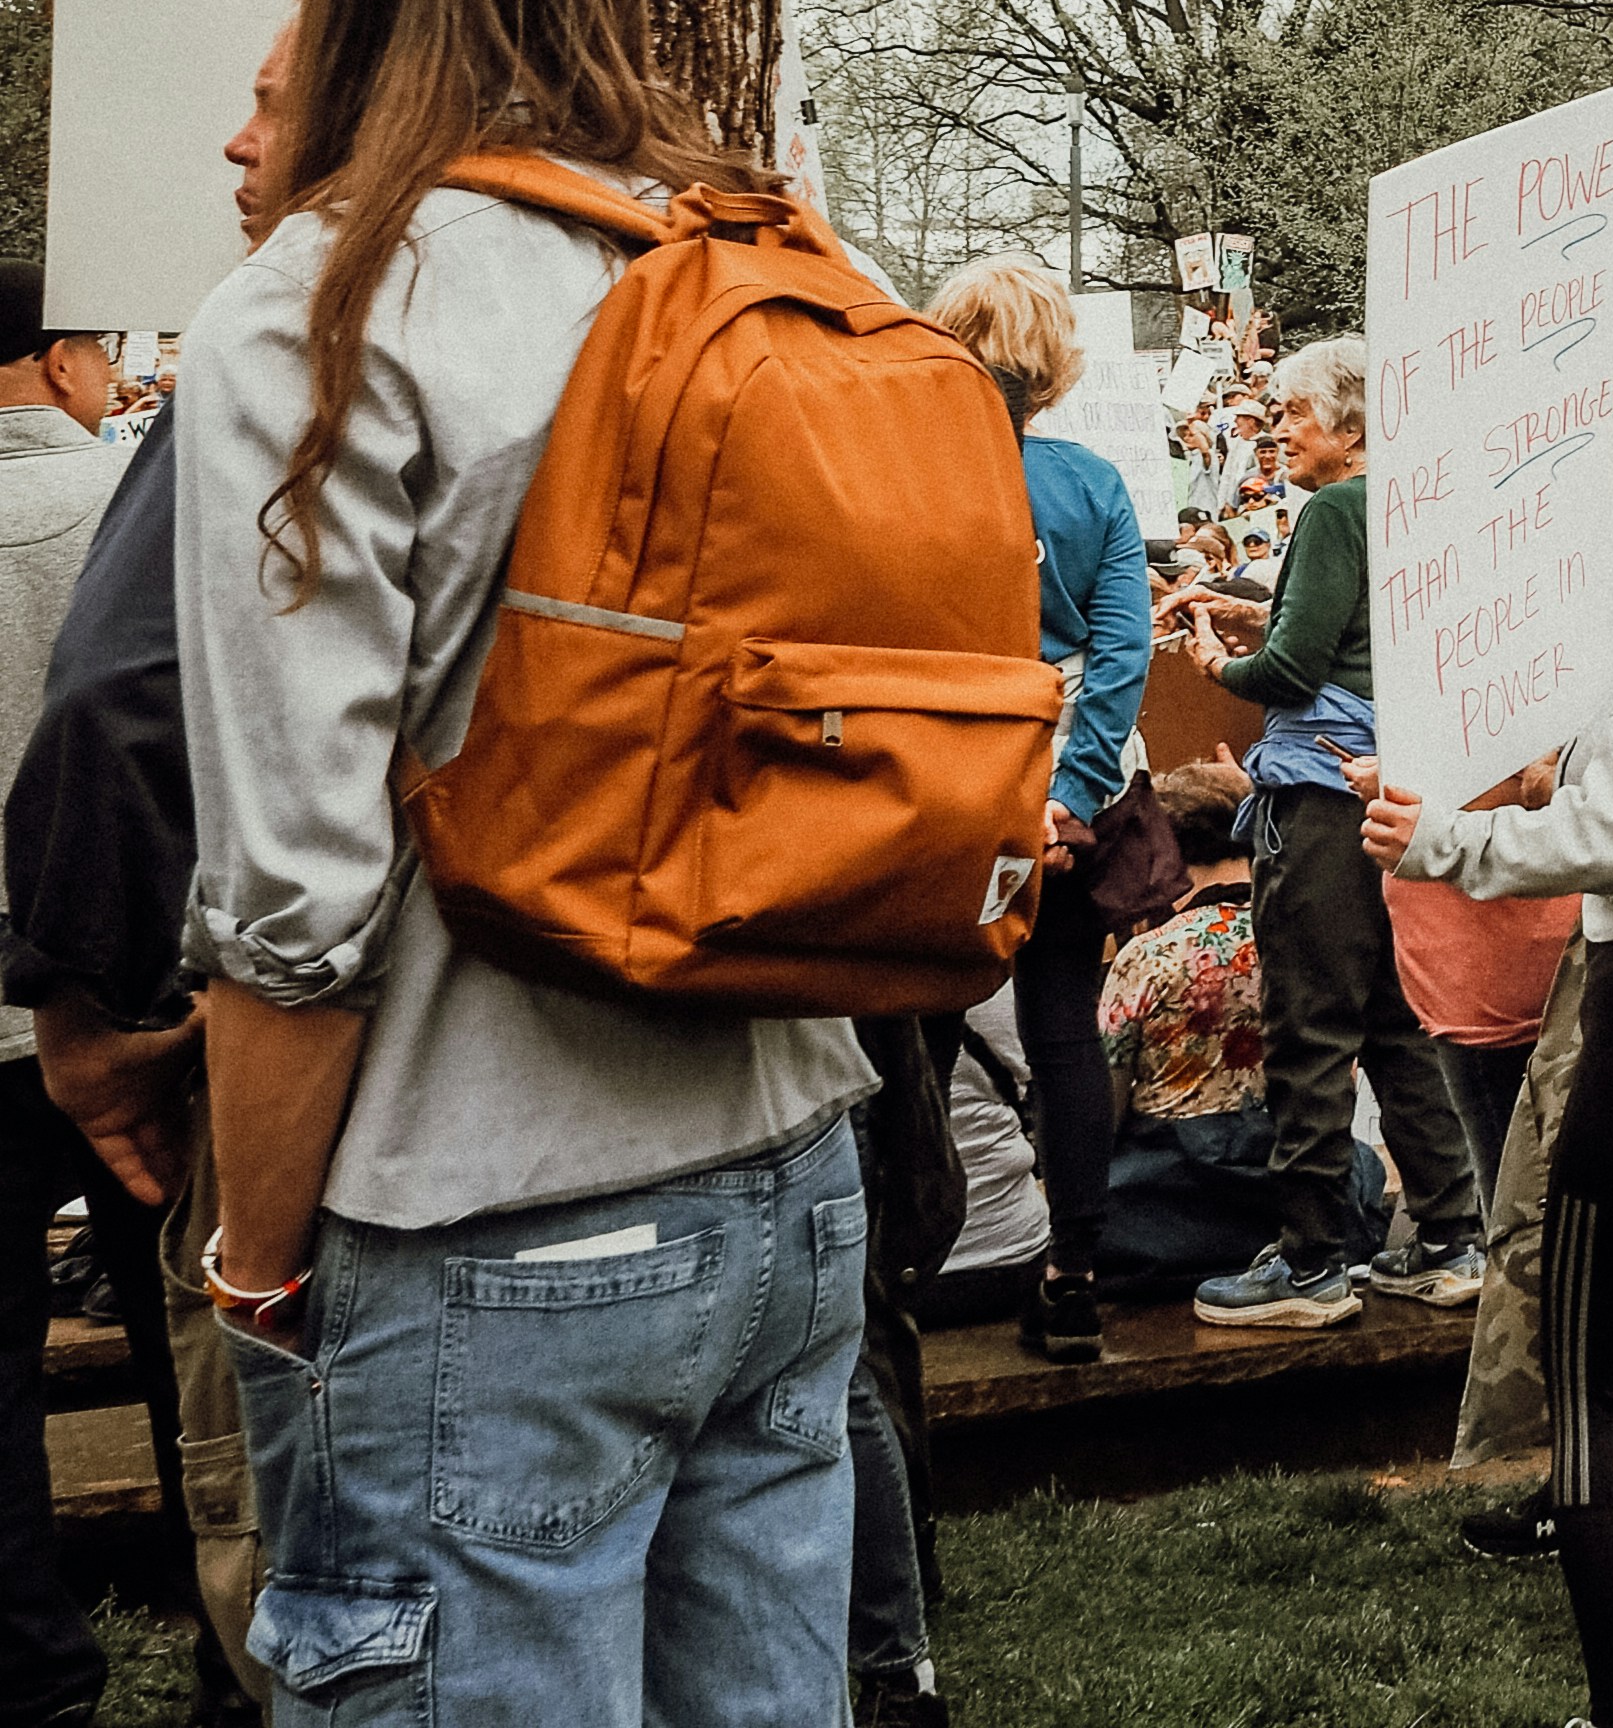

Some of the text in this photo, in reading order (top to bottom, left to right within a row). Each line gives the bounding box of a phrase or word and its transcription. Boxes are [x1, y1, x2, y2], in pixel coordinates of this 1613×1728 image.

[1385, 176, 1490, 301] THE
[1380, 349, 1422, 442] OF
[1437, 318, 1499, 391] THE
[1520, 268, 1608, 347] PEOPLE
[1380, 483, 1554, 647] THAN THE
[1385, 448, 1456, 549] ARE
[1435, 550, 1586, 697] PEOPLE IN
[1460, 642, 1575, 758] POWER
